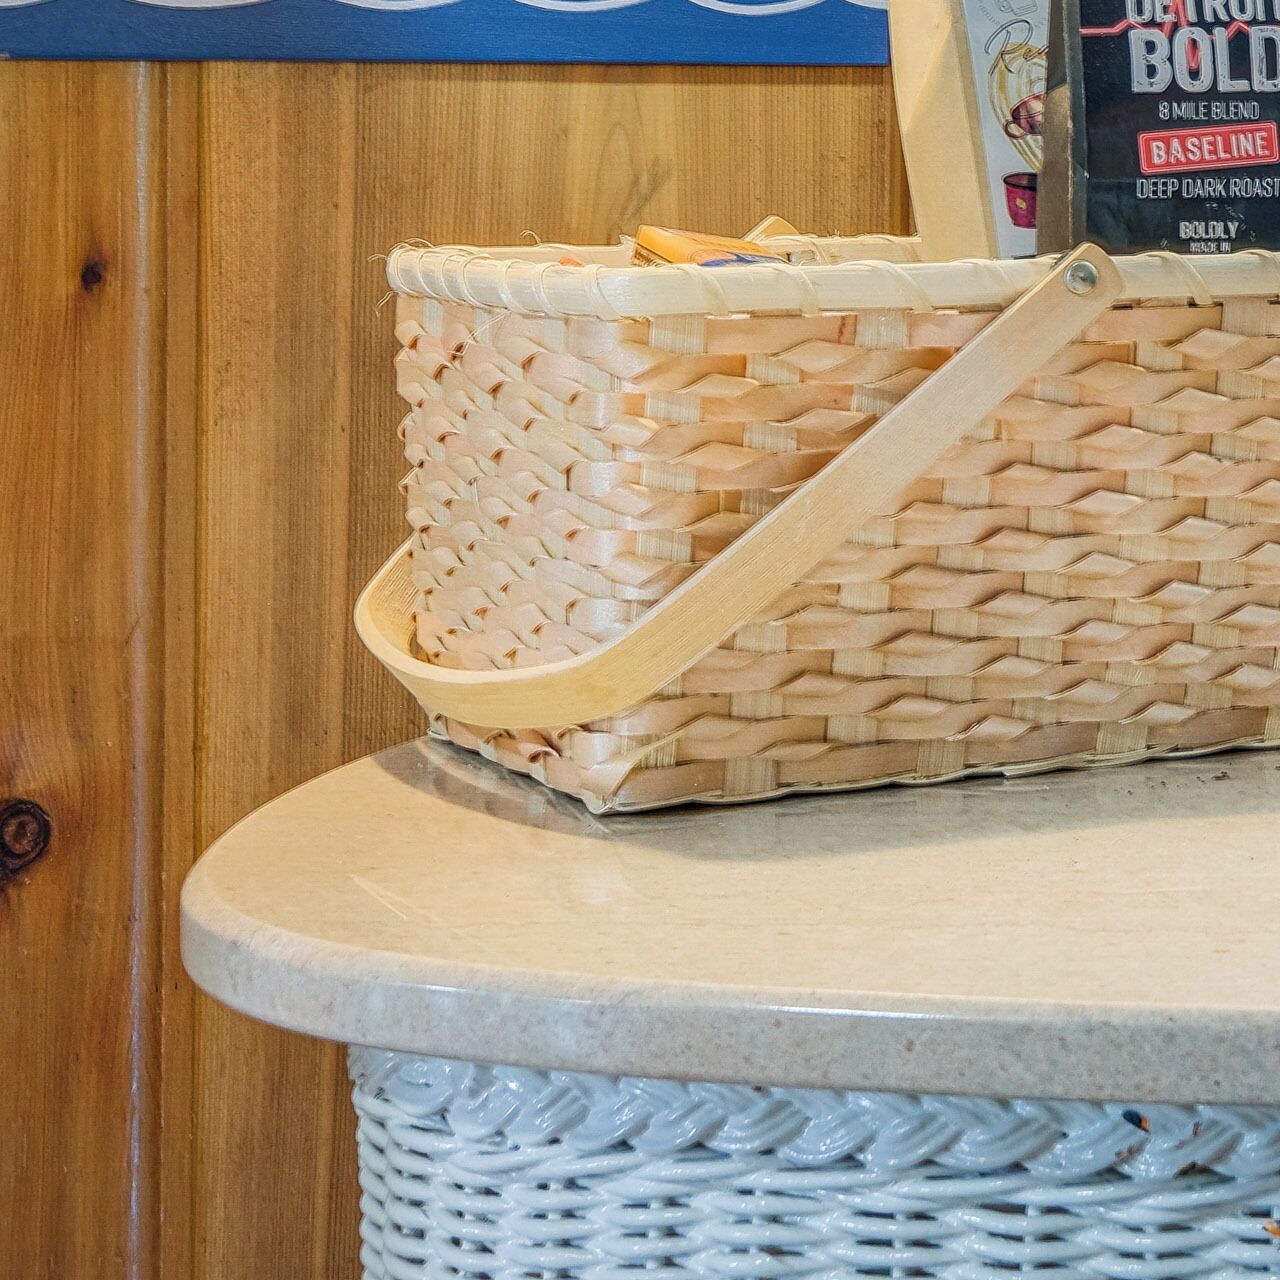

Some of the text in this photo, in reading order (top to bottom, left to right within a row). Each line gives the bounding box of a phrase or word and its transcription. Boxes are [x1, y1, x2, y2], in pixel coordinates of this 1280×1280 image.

[1159, 100, 1260, 120] 8 MILE BLEND
[1151, 130, 1269, 165] BASELINE
[1136, 178, 1179, 199] DEEP
[1182, 178, 1227, 199] DARK
[1179, 221, 1239, 239] BOLDLY
